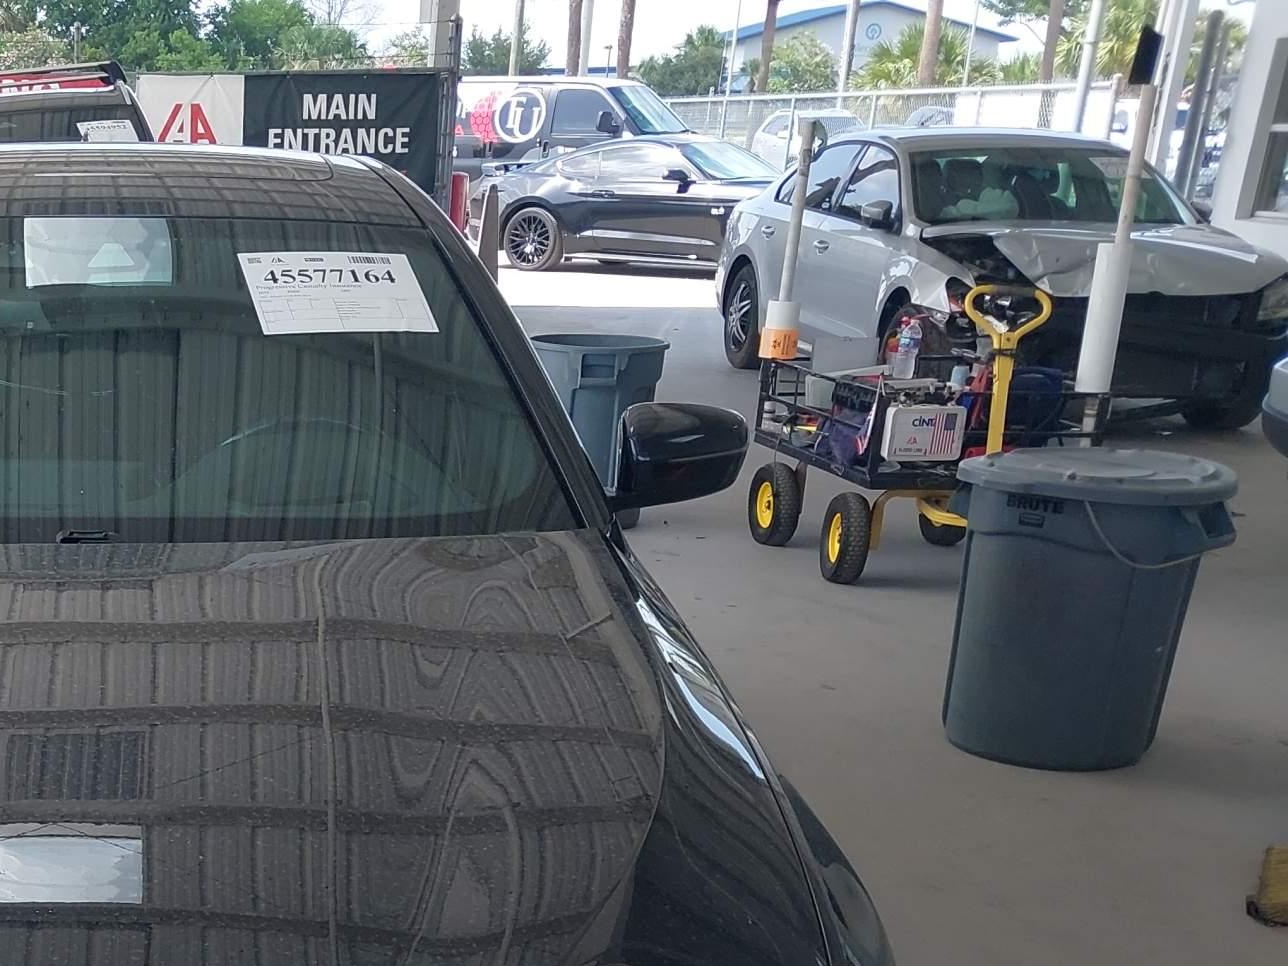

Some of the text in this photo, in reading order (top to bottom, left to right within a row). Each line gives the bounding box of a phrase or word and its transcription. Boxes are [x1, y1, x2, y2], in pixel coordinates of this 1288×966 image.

[302, 93, 377, 120] MAIN
[268, 127, 410, 154] ENTRANCE
[263, 269, 396, 284] 45577164
[912, 416, 936, 427] CINT
[1006, 494, 1065, 515] BRUTE
